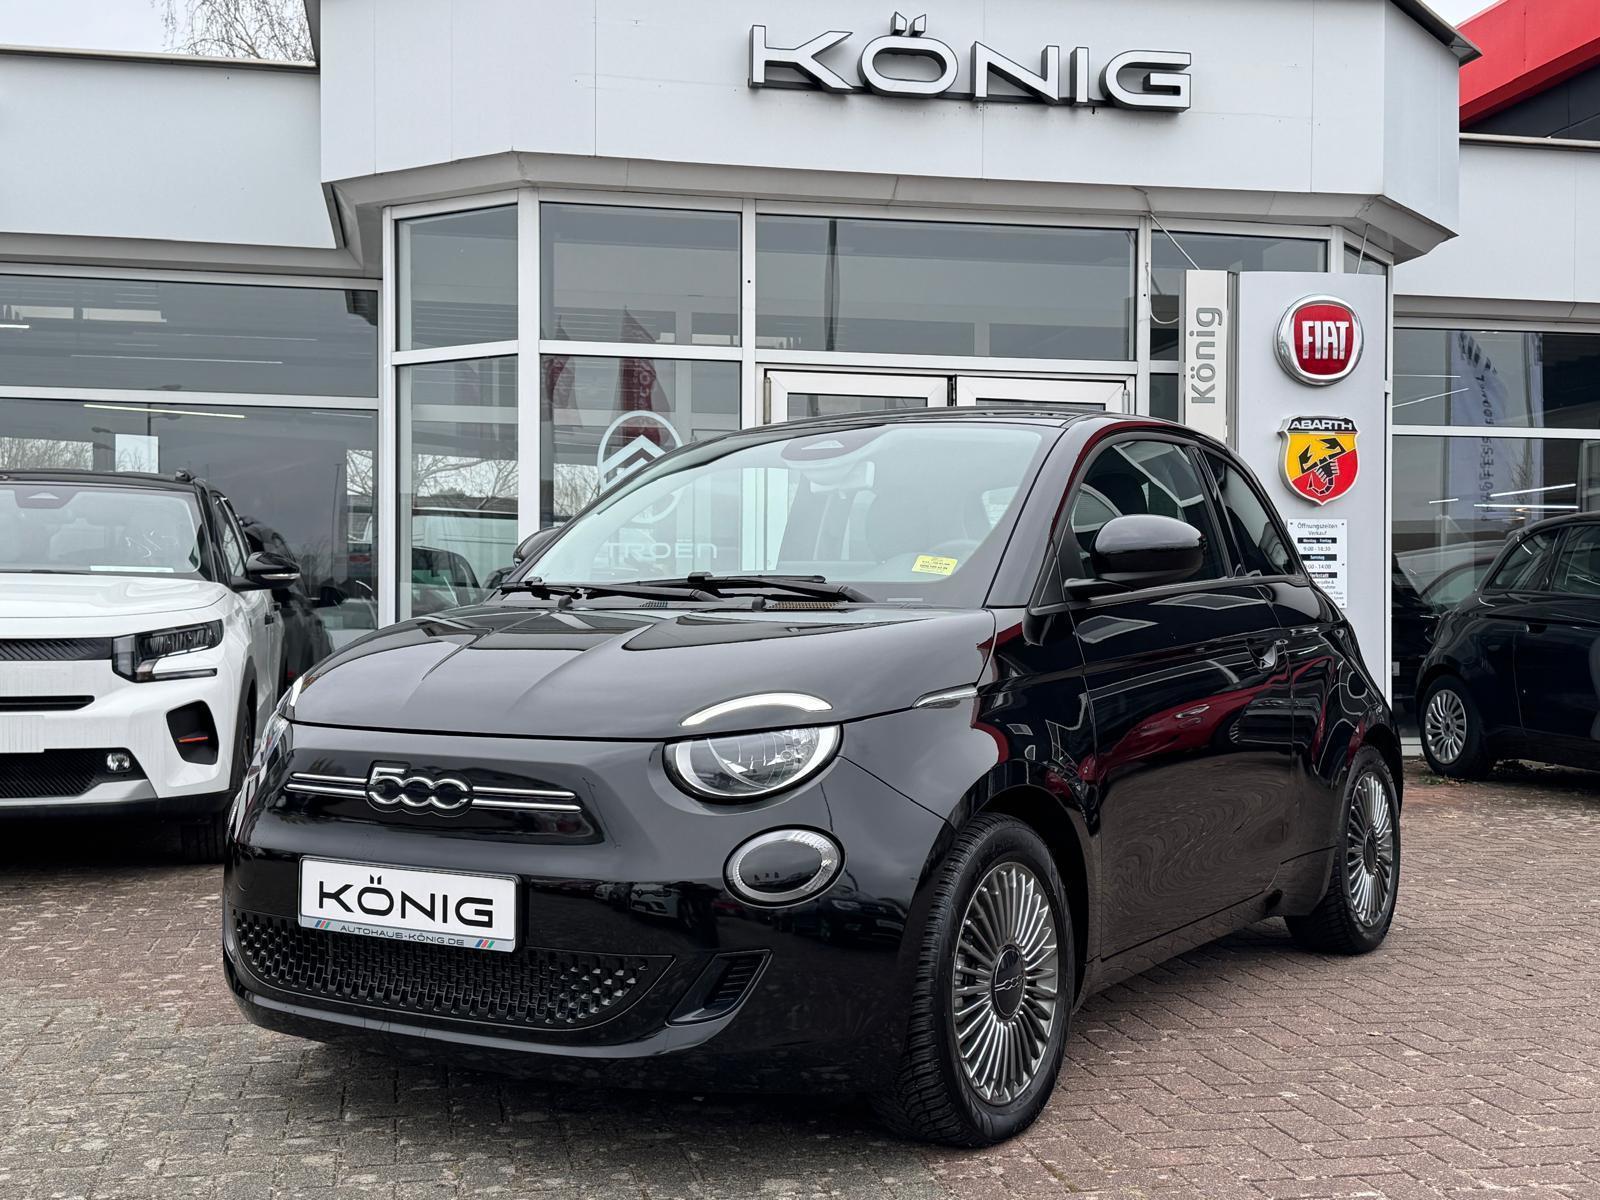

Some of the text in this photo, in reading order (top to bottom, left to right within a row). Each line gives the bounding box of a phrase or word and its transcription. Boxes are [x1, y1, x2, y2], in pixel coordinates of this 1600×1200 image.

[748, 11, 1192, 113] KÖNIG
[1189, 307, 1222, 404] König
[1301, 320, 1350, 360] FIAT
[1290, 420, 1353, 430] ABARTH
[1296, 522, 1338, 530] Öffnungszeiten
[368, 766, 469, 810] 500
[319, 874, 494, 928] KÖNIG
[339, 925, 465, 946] AUTOHAUS-KÖNIG.DE
